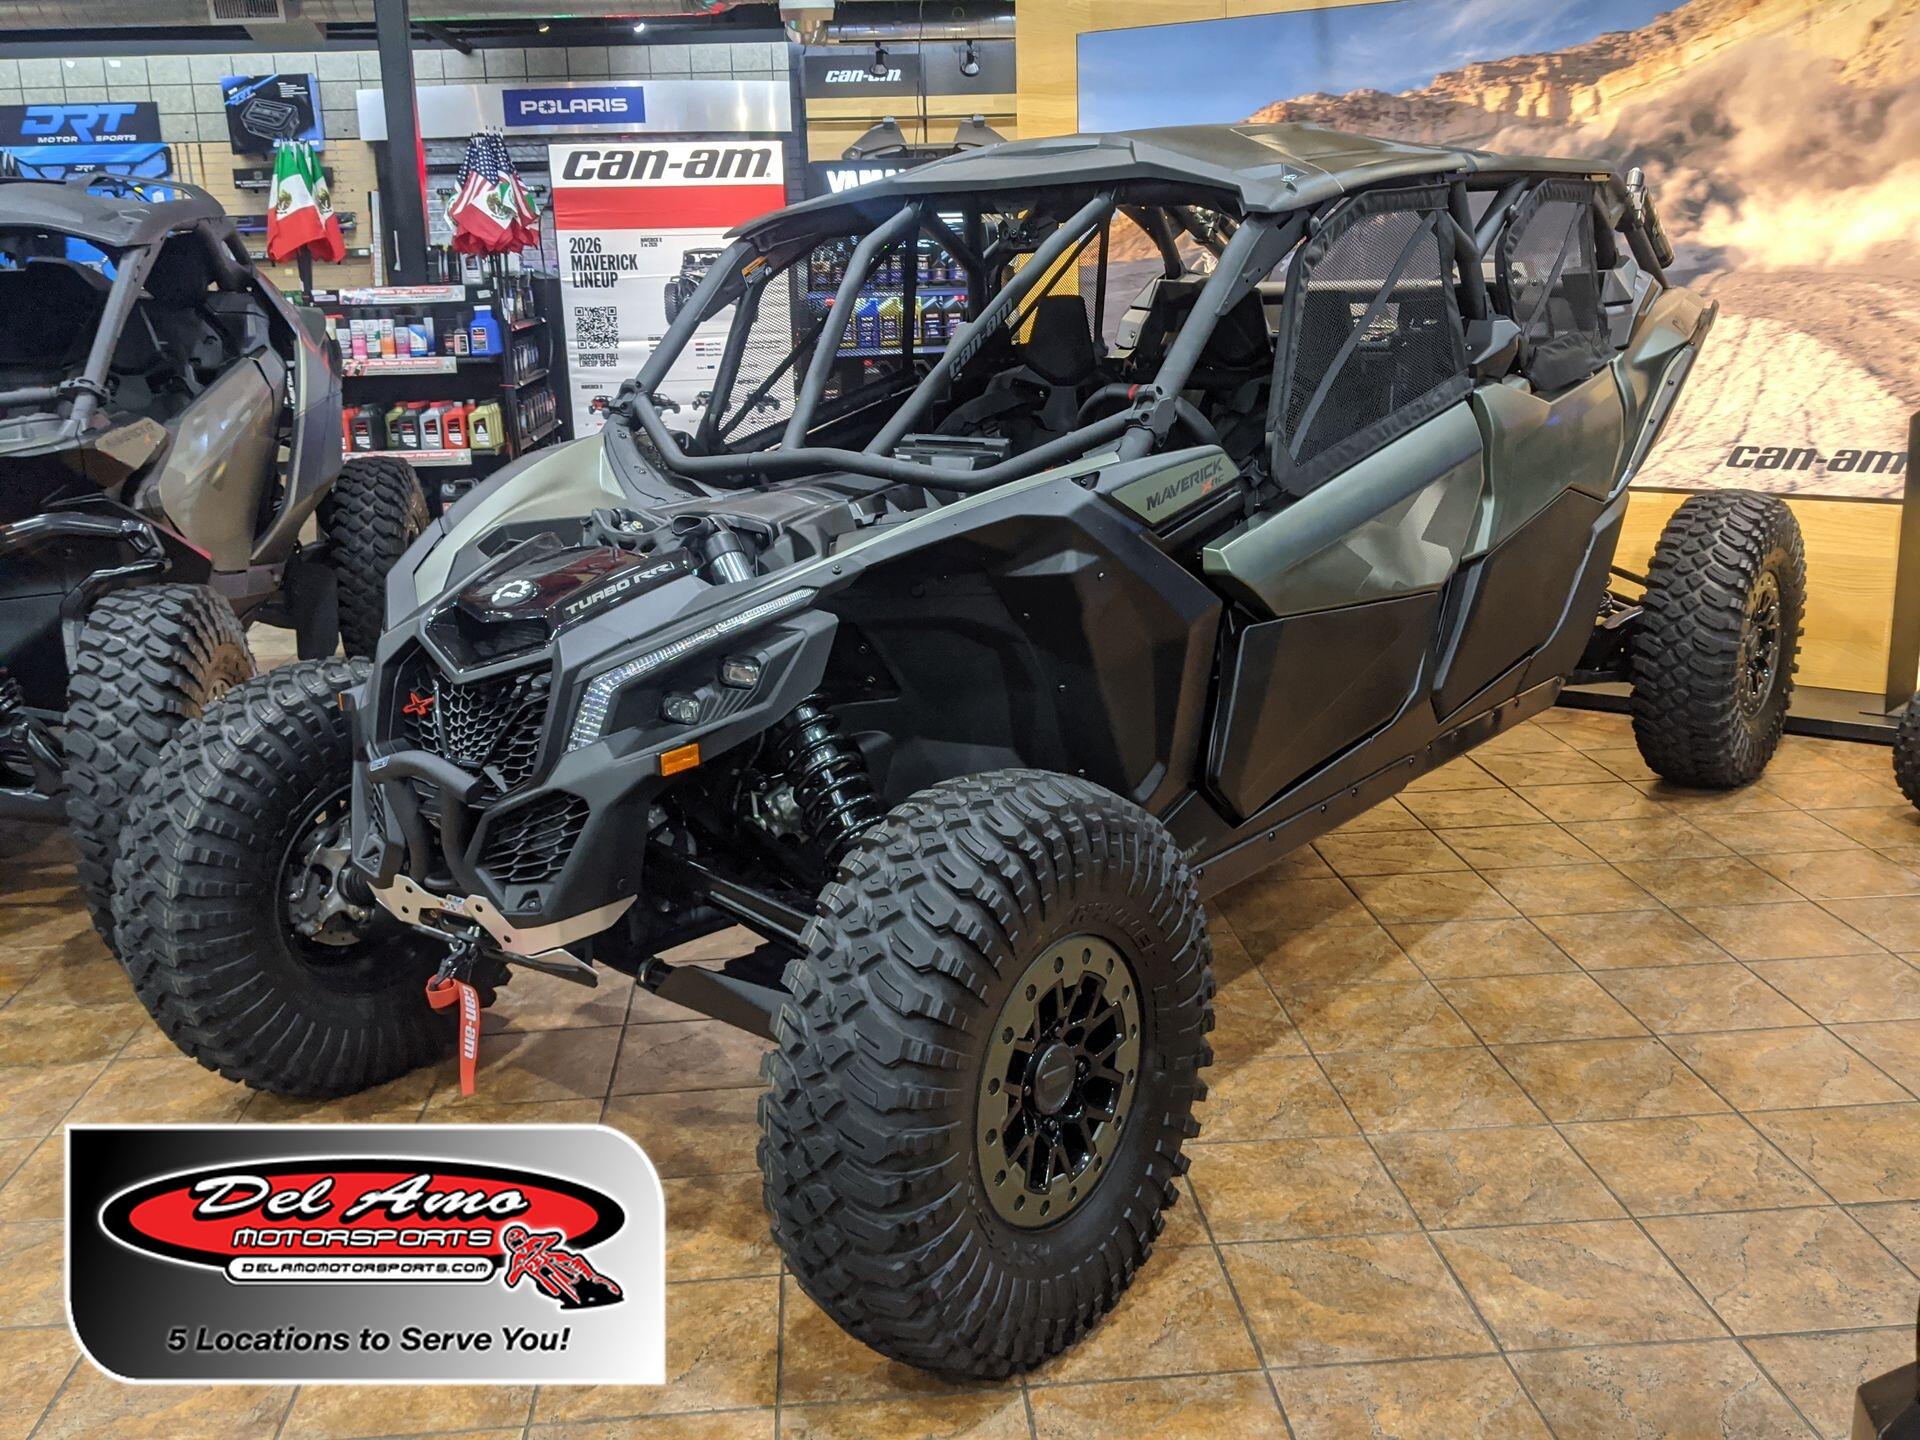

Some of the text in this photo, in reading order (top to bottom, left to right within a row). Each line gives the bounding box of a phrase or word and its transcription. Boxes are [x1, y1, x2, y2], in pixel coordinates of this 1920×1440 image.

[520, 97, 629, 116] POLARIS
[21, 103, 138, 143] DRT
[95, 134, 137, 142] SPORTS
[561, 148, 772, 181] can-am
[826, 168, 906, 194] YAM
[569, 237, 602, 254] 2026
[571, 254, 639, 271] MAVERICK
[572, 272, 619, 288] LINEUP
[949, 297, 1013, 379] can-am
[1726, 445, 1908, 475] can-am
[1146, 457, 1223, 511] MAVERICK
[565, 579, 631, 615] TURBO
[462, 985, 476, 1059] can-am
